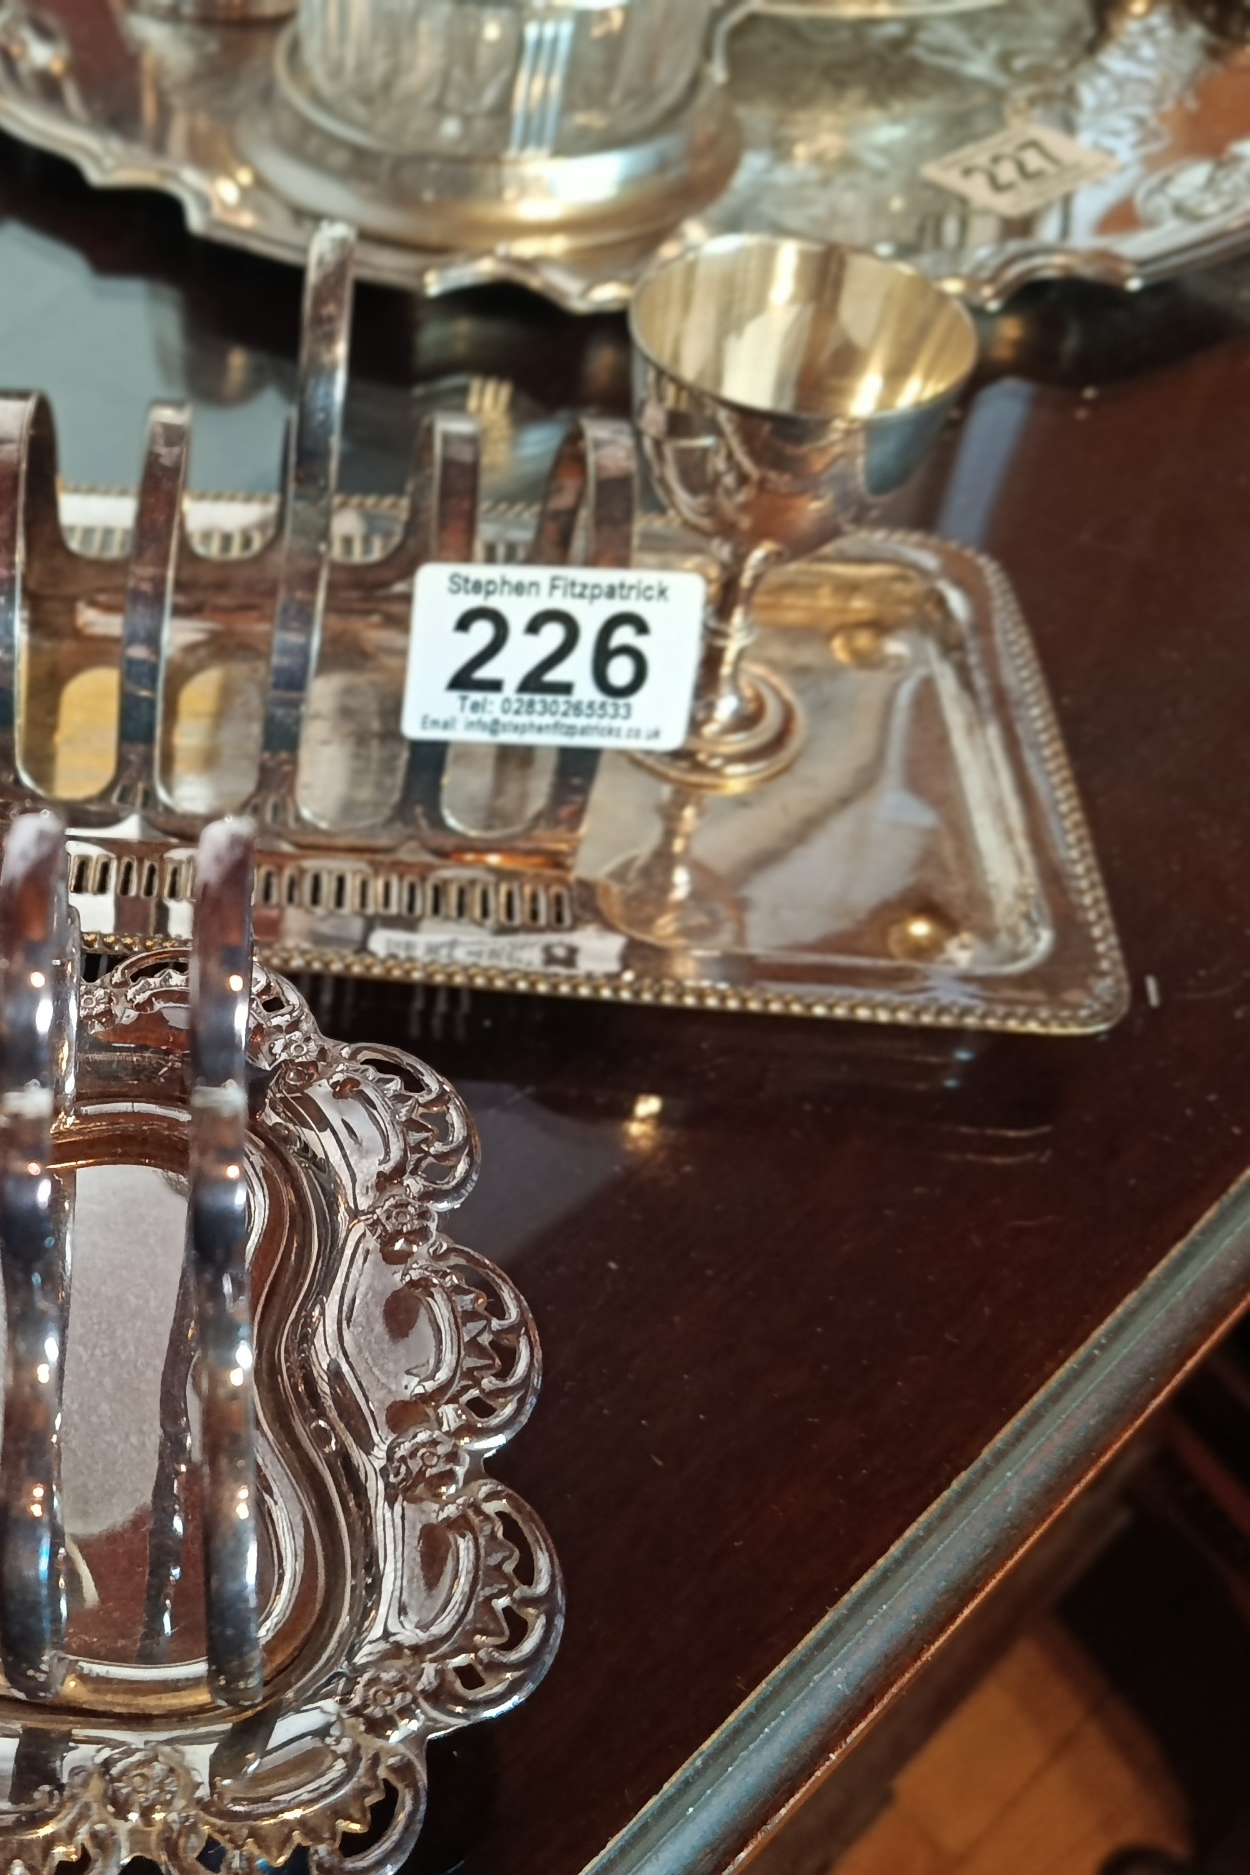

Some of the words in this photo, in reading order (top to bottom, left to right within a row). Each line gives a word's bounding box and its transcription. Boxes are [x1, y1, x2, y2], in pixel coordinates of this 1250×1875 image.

[961, 138, 1065, 193] 227
[448, 572, 540, 600] Stephen
[548, 575, 670, 604] Fitzpatrick
[445, 605, 652, 700] 226
[458, 694, 494, 715] Tel:
[500, 697, 633, 720] 02830265533
